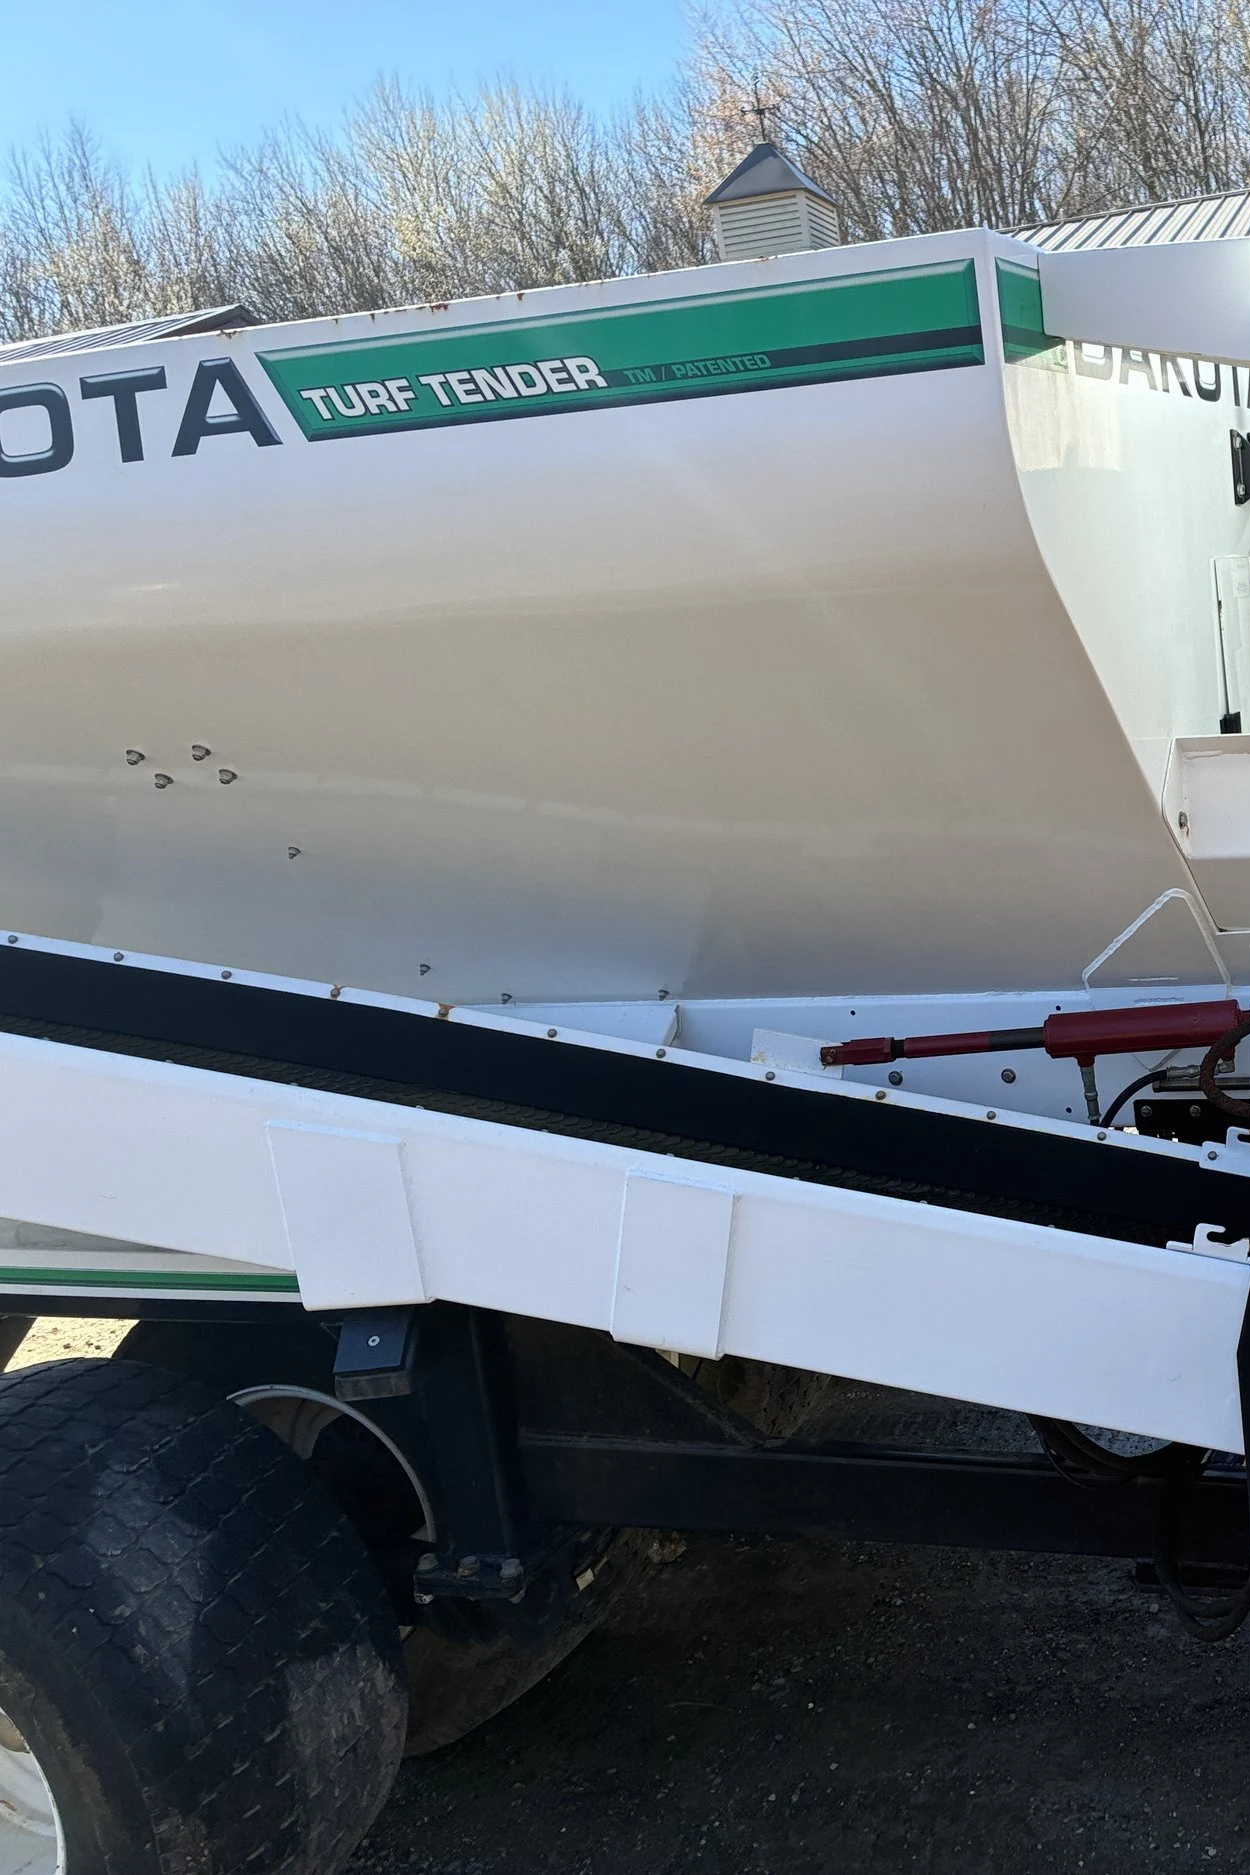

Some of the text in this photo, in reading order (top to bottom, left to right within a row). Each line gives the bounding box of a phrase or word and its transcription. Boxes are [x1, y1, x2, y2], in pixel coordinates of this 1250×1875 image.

[299, 354, 609, 421] TURF TENDER
[624, 367, 656, 384] TM
[673, 354, 772, 379] PATENTED
